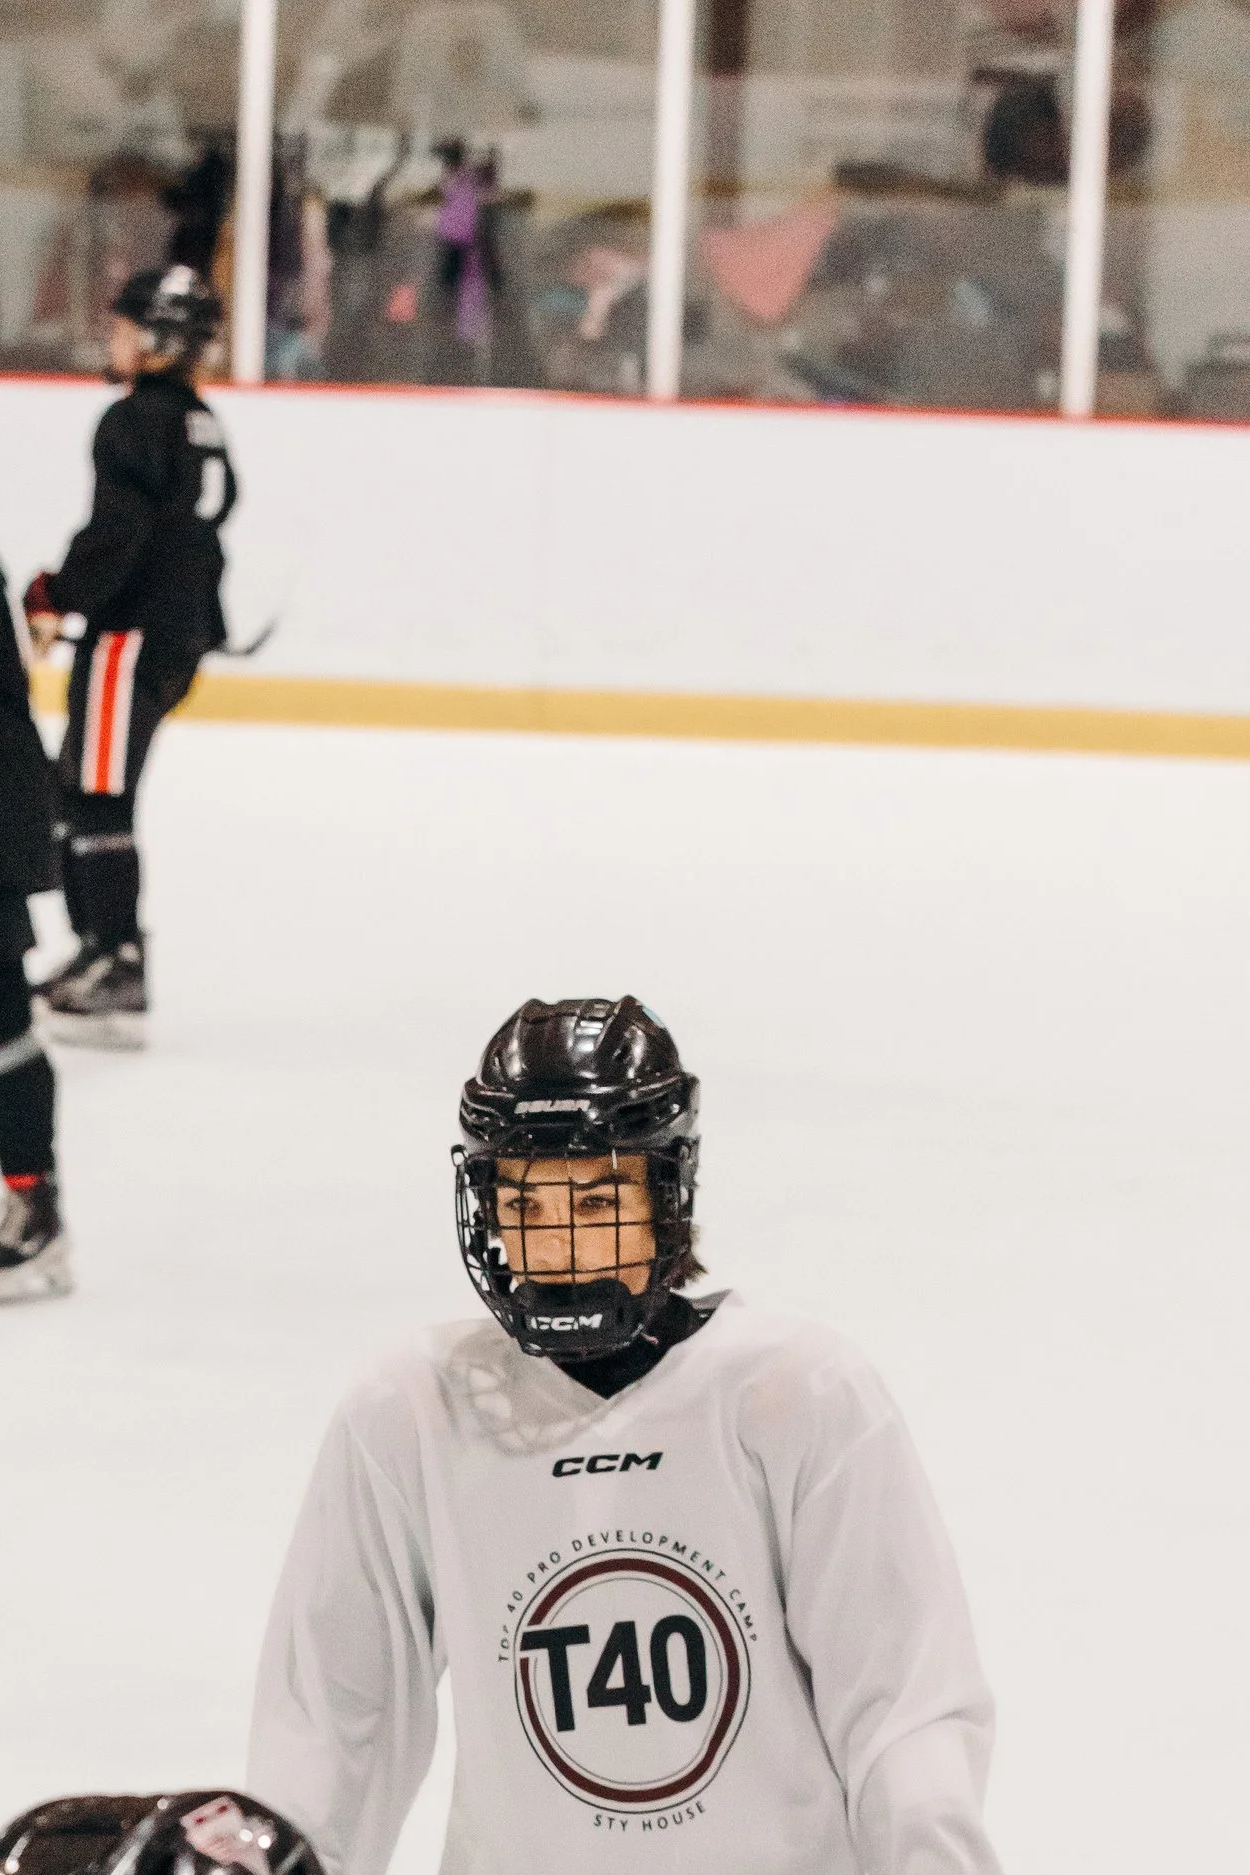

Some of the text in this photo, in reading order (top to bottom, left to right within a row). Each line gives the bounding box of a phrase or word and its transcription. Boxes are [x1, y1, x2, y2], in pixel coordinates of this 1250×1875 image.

[551, 1451, 664, 1478] CCM
[507, 1591, 523, 1613] 40
[527, 1551, 561, 1583] PRO
[572, 1530, 726, 1581] DEVELOPMENT
[729, 1589, 757, 1642] CAMP
[520, 1613, 707, 1732] T40
[593, 1801, 705, 1832] STY HOUSE
